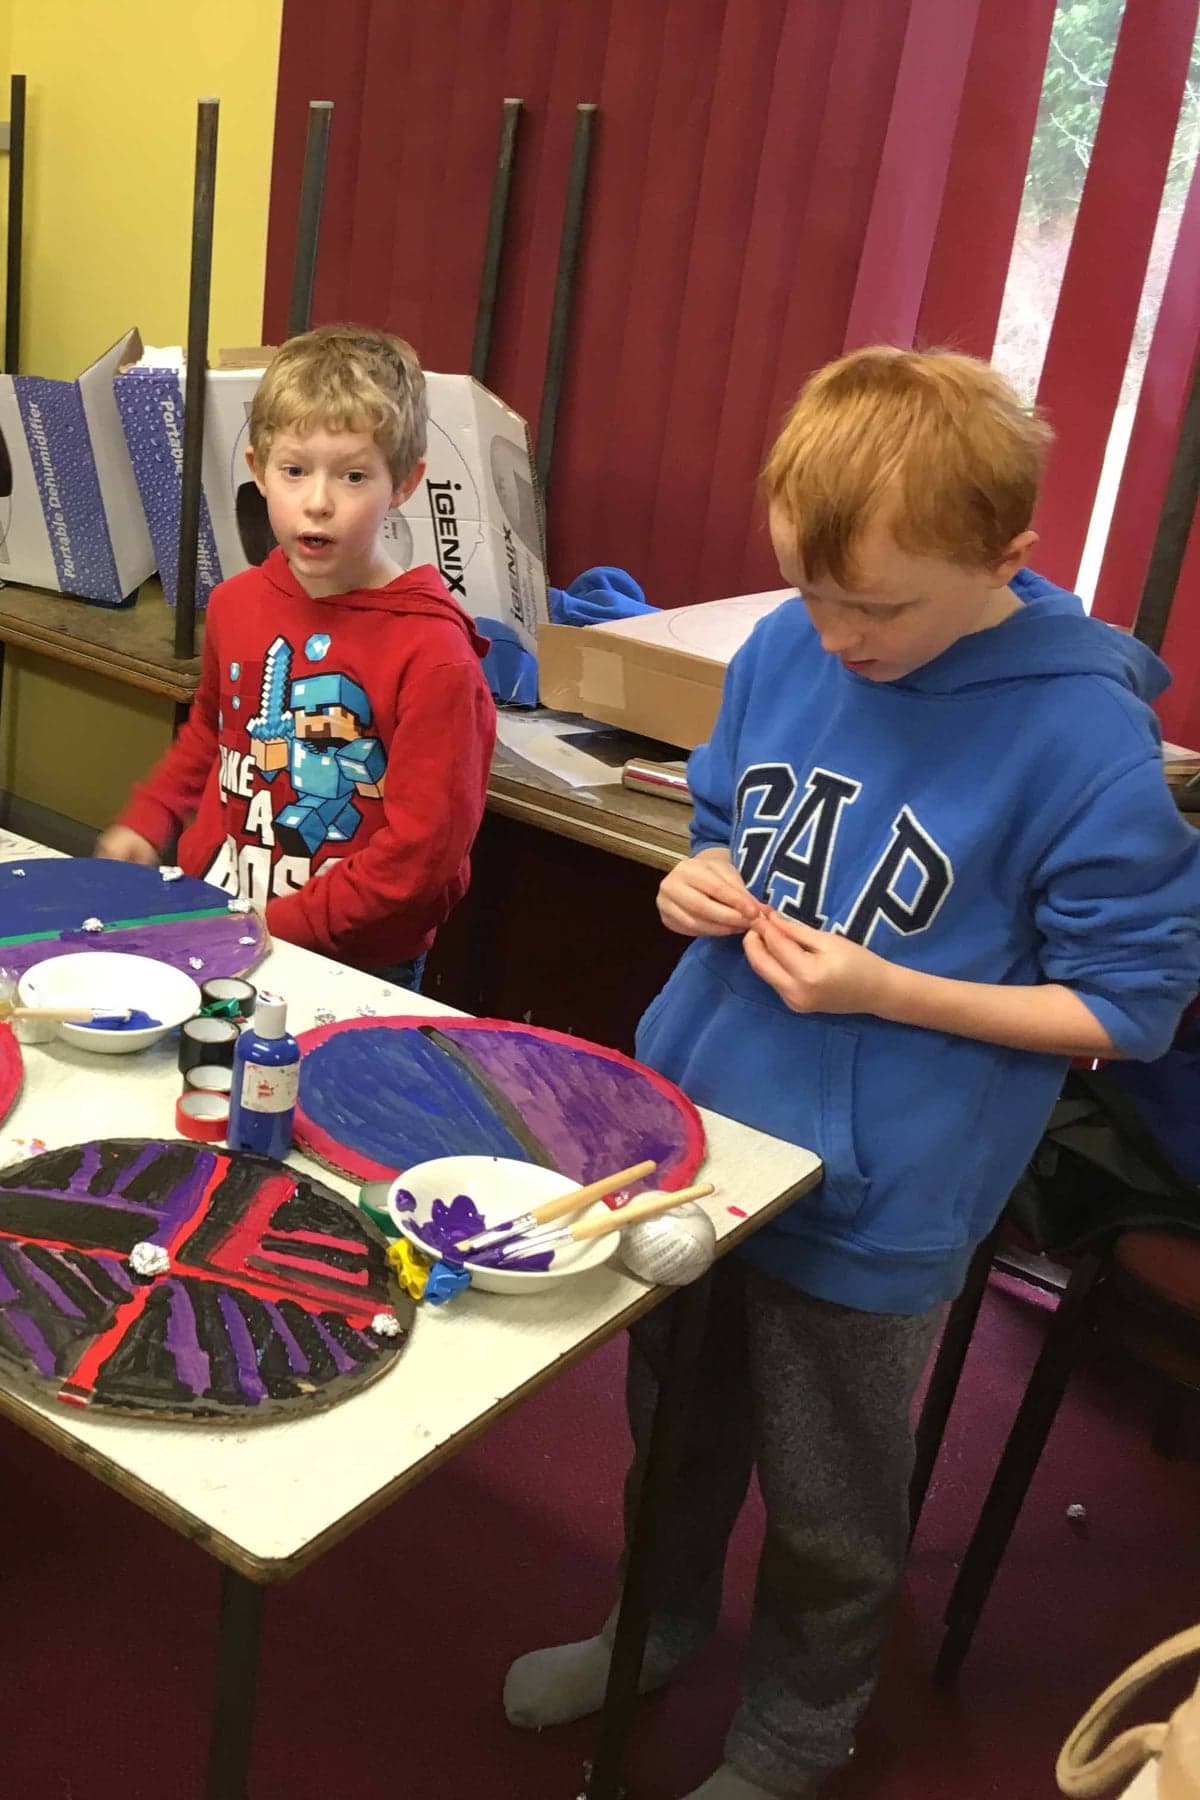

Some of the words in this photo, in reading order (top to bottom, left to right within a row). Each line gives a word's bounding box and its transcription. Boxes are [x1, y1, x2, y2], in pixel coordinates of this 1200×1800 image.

[26, 399, 64, 510] Dehumidifier
[51, 511, 75, 580] Portable
[245, 789, 275, 847] A
[736, 762, 953, 947] GAP
